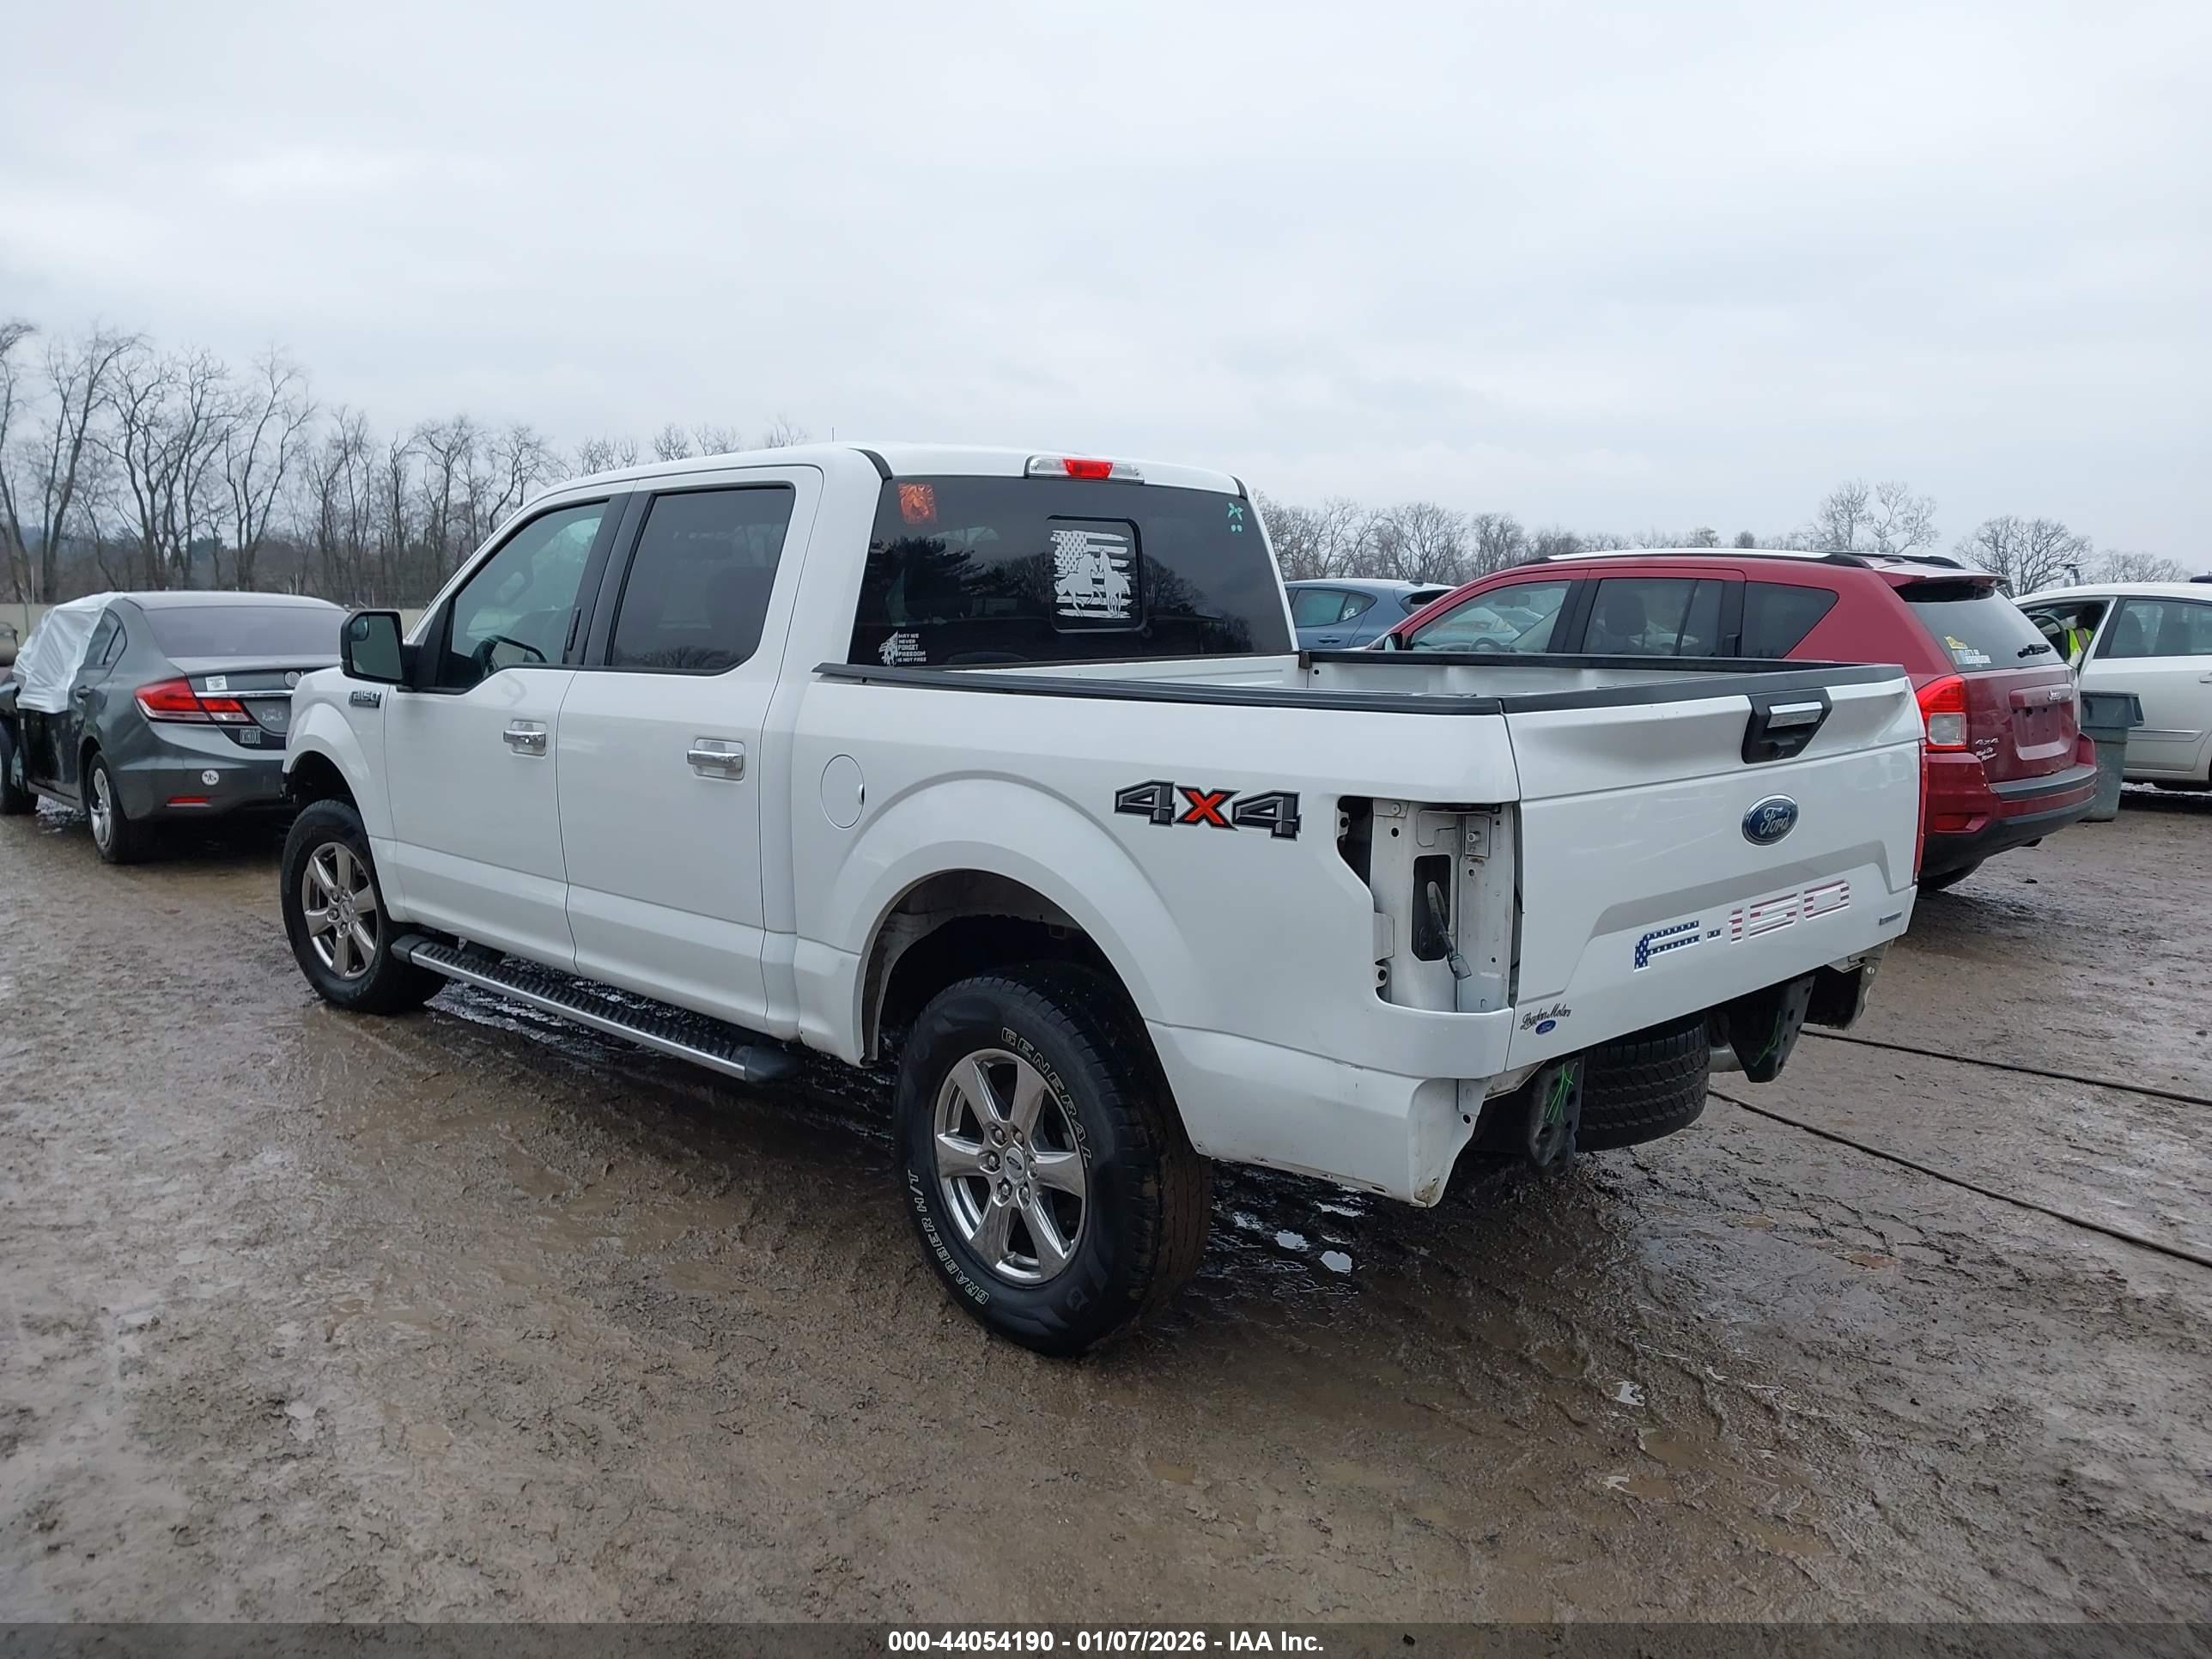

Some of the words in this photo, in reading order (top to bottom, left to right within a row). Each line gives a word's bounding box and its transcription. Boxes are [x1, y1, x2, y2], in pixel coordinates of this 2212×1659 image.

[1759, 806, 1791, 836] Ford
[1633, 878, 1851, 973] F-150
[1001, 1027, 1092, 1168] GENERAL
[907, 1169, 927, 1213] H/T
[921, 1217, 990, 1305] GRABBER
